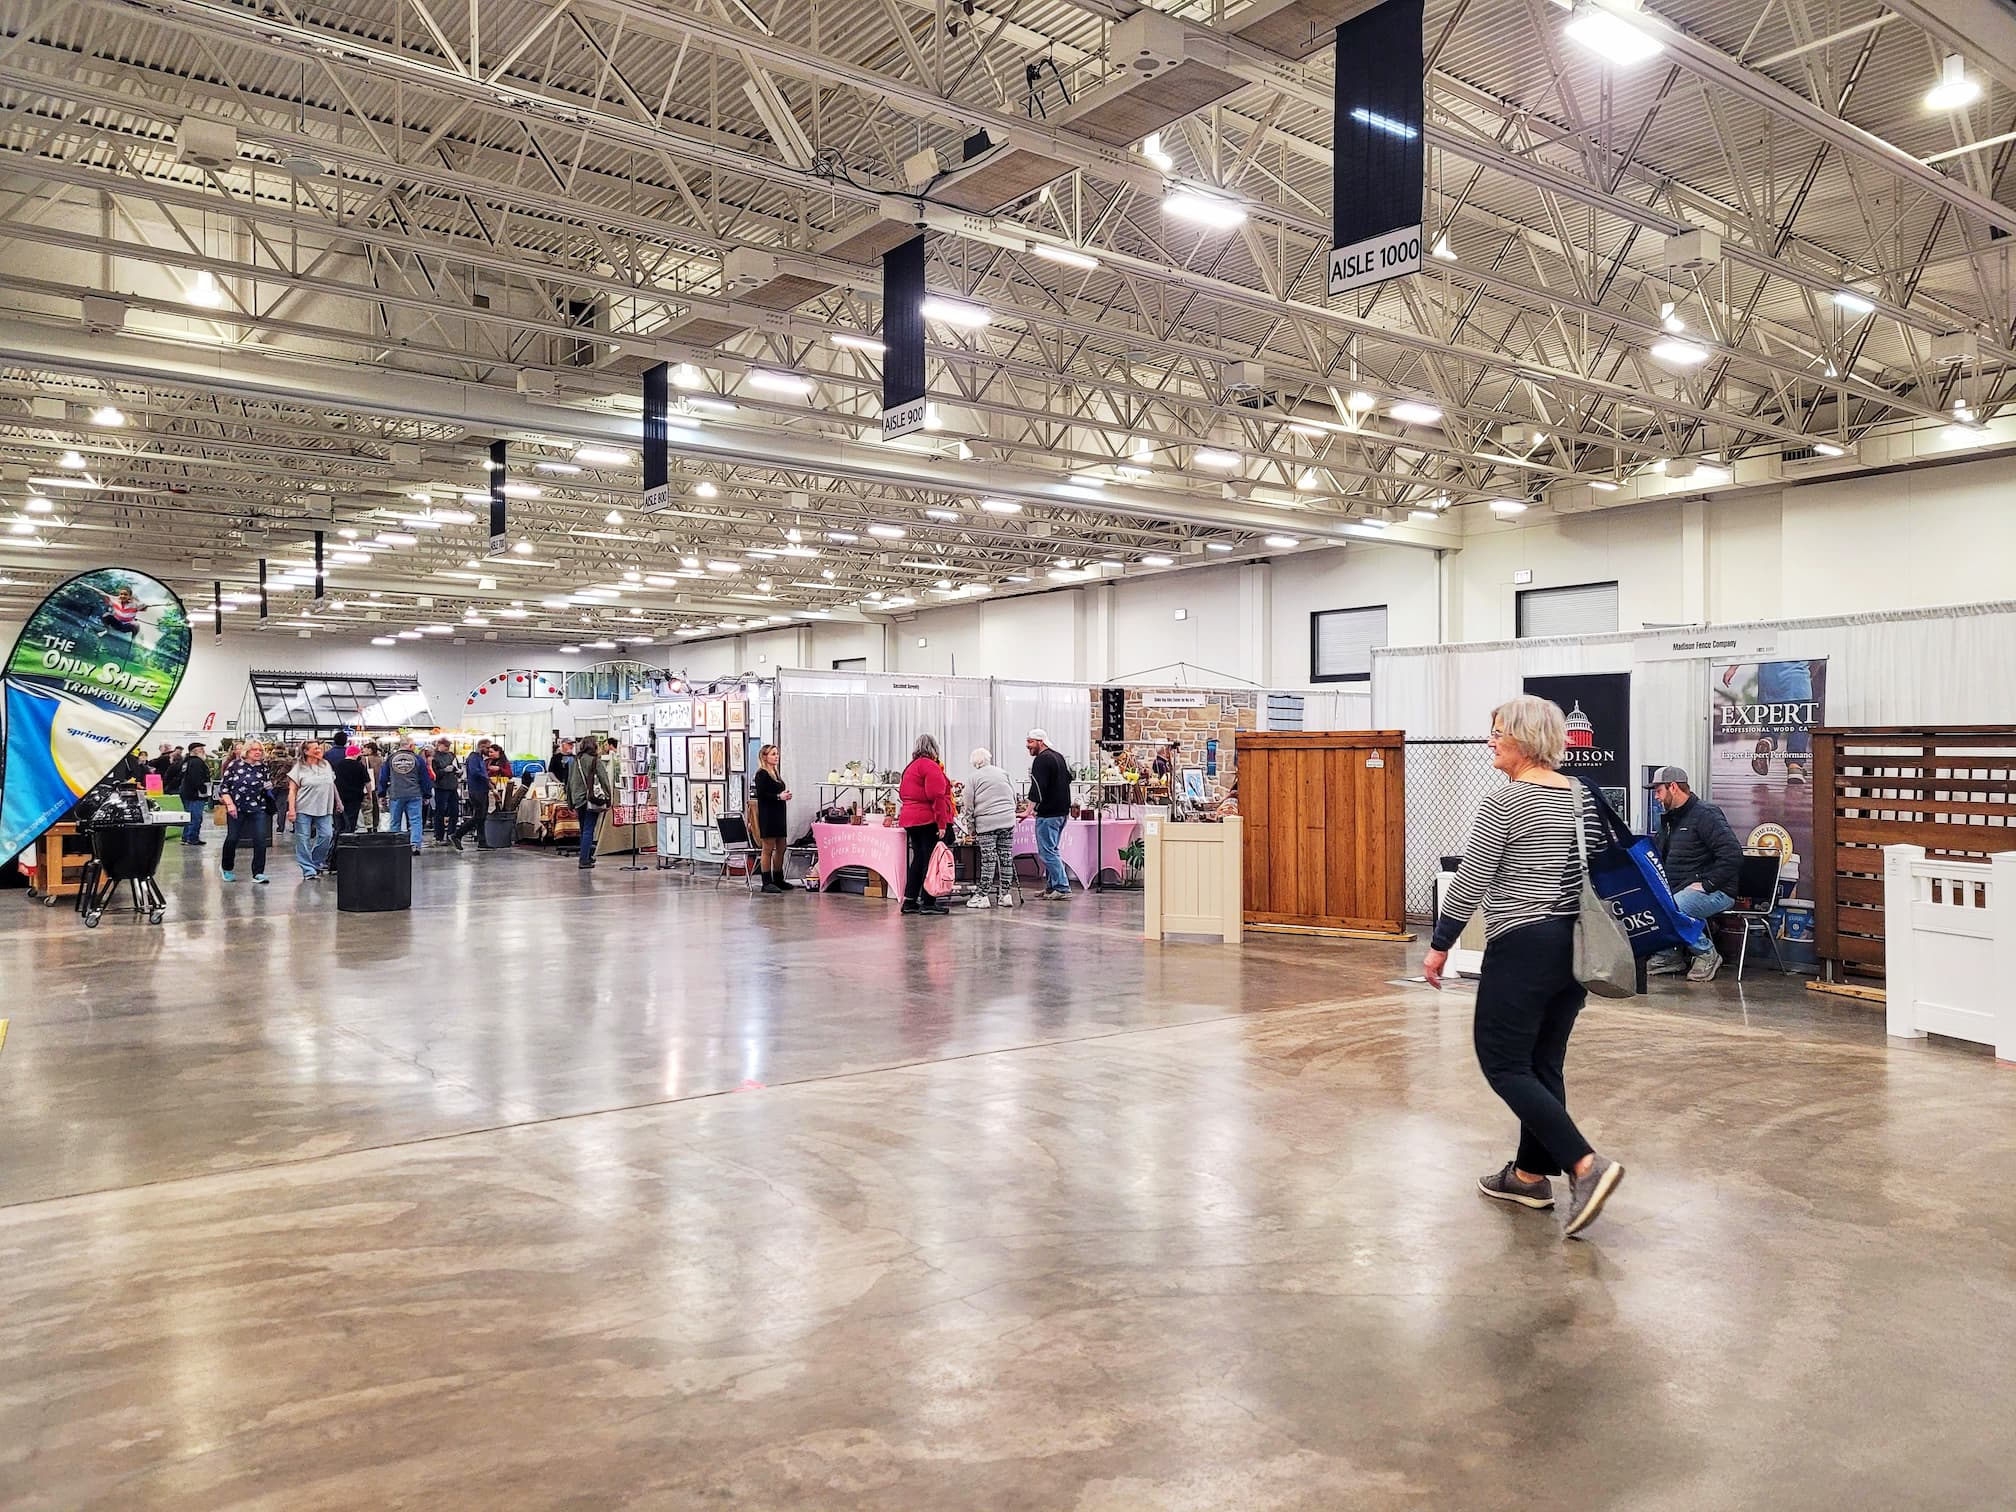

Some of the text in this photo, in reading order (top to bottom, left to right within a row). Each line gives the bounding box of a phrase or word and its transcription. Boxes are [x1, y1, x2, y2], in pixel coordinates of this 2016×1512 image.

[1331, 238, 1420, 283] AISLE 1000
[885, 406, 923, 432] AISLE 900
[43, 634, 76, 653] THE
[1672, 640, 1737, 651] Madison Fence Company
[42, 649, 161, 698] ONLY SAFE
[63, 679, 142, 712] TRAMPOLINE
[1720, 702, 1820, 726] EXPERT
[67, 727, 128, 748] springfree
[1721, 726, 1771, 734] PROFESSIONAL
[1564, 750, 1616, 762] DISON
[1744, 751, 1769, 761] Expert
[1769, 750, 1814, 760] Performanc
[831, 846, 849, 859] Green
